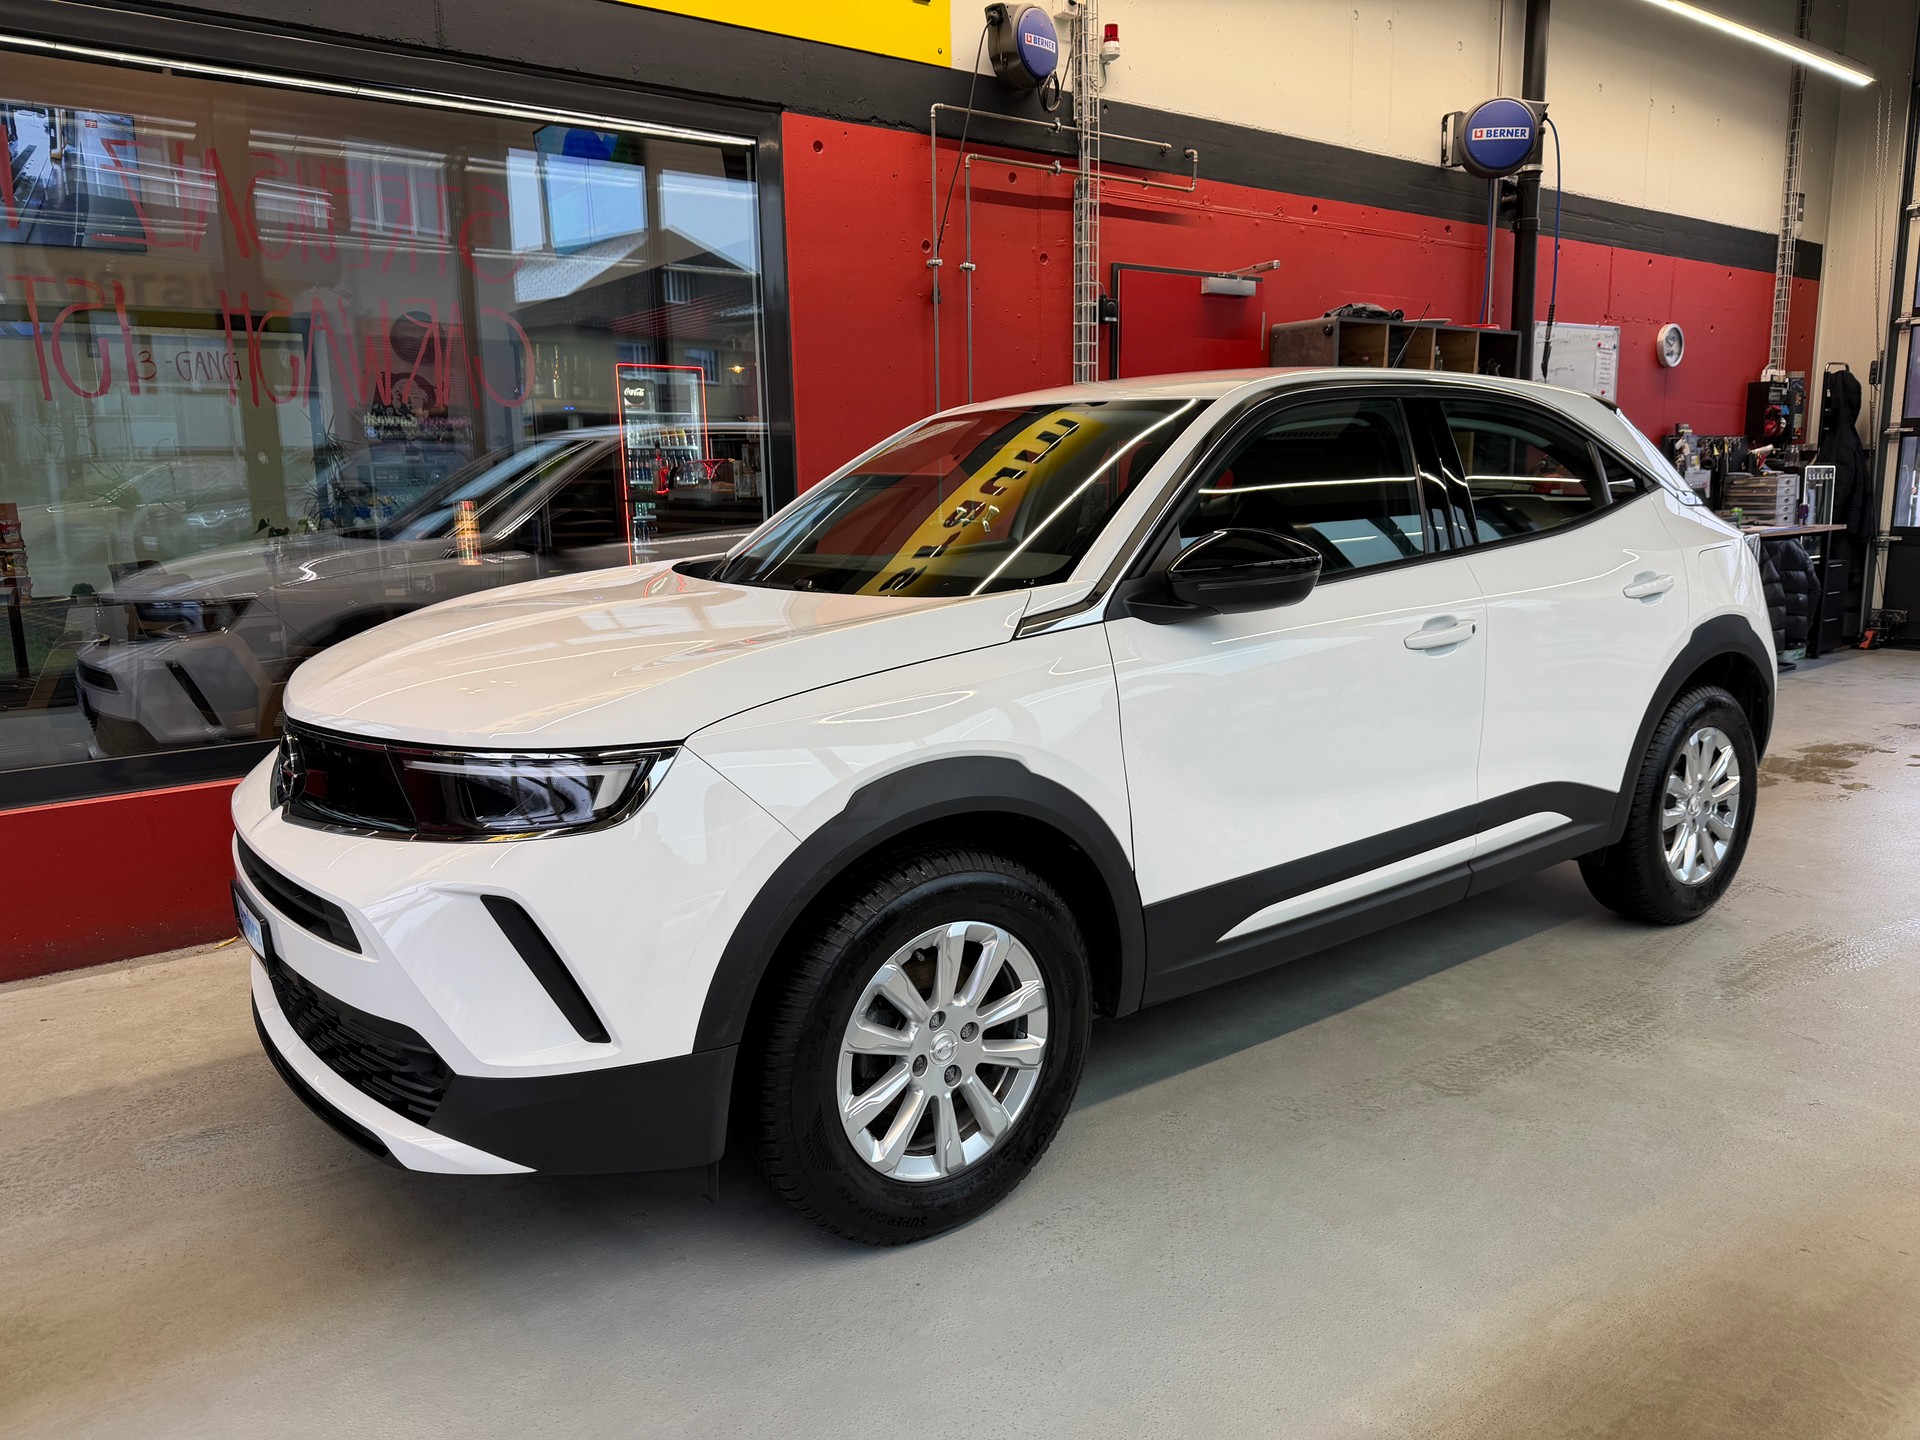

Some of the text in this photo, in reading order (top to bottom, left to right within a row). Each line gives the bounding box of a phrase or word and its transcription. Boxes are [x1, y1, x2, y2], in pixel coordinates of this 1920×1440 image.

[1033, 35, 1055, 51] BERNER
[1486, 128, 1527, 138] BERNER
[857, 1205, 929, 1229] SUPERGRIP
